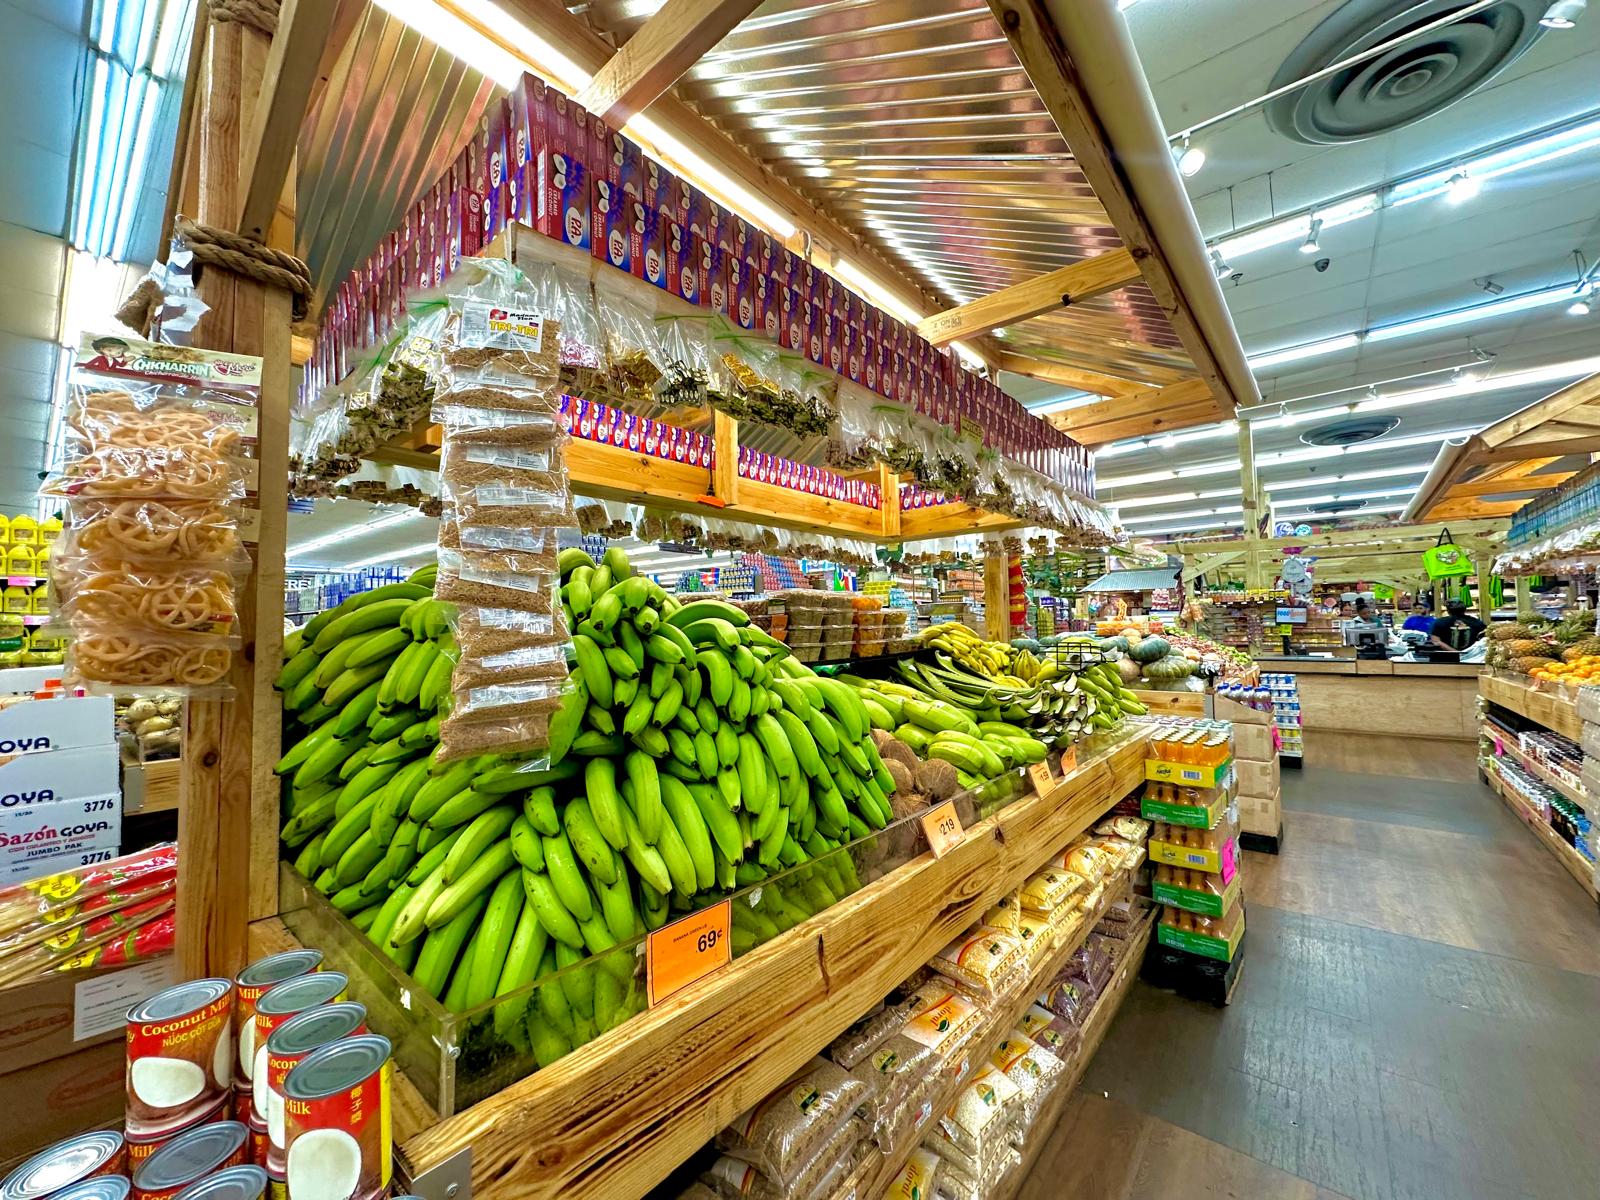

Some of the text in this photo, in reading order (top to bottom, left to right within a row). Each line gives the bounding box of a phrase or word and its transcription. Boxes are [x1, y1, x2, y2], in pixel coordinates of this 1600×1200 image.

[571, 217, 582, 238] P.A.
[613, 239, 623, 260] P.A.
[650, 257, 659, 277] P.A.
[684, 275, 692, 293] P.A.
[714, 291, 722, 309] P.A.
[742, 305, 750, 322] P.A.
[489, 321, 538, 337] TRI-TRI
[0, 737, 50, 754] OYA
[1, 789, 54, 807] OYA
[84, 799, 114, 813] 3776
[0, 821, 109, 848] Sazón GOYA
[27, 846, 60, 857] JUMBO
[65, 842, 82, 851] PAK
[81, 851, 111, 866] 3776
[238, 988, 262, 999] Milk
[142, 1010, 207, 1037] Coconut
[929, 1005, 953, 1027] doral
[902, 1164, 920, 1199] doral
